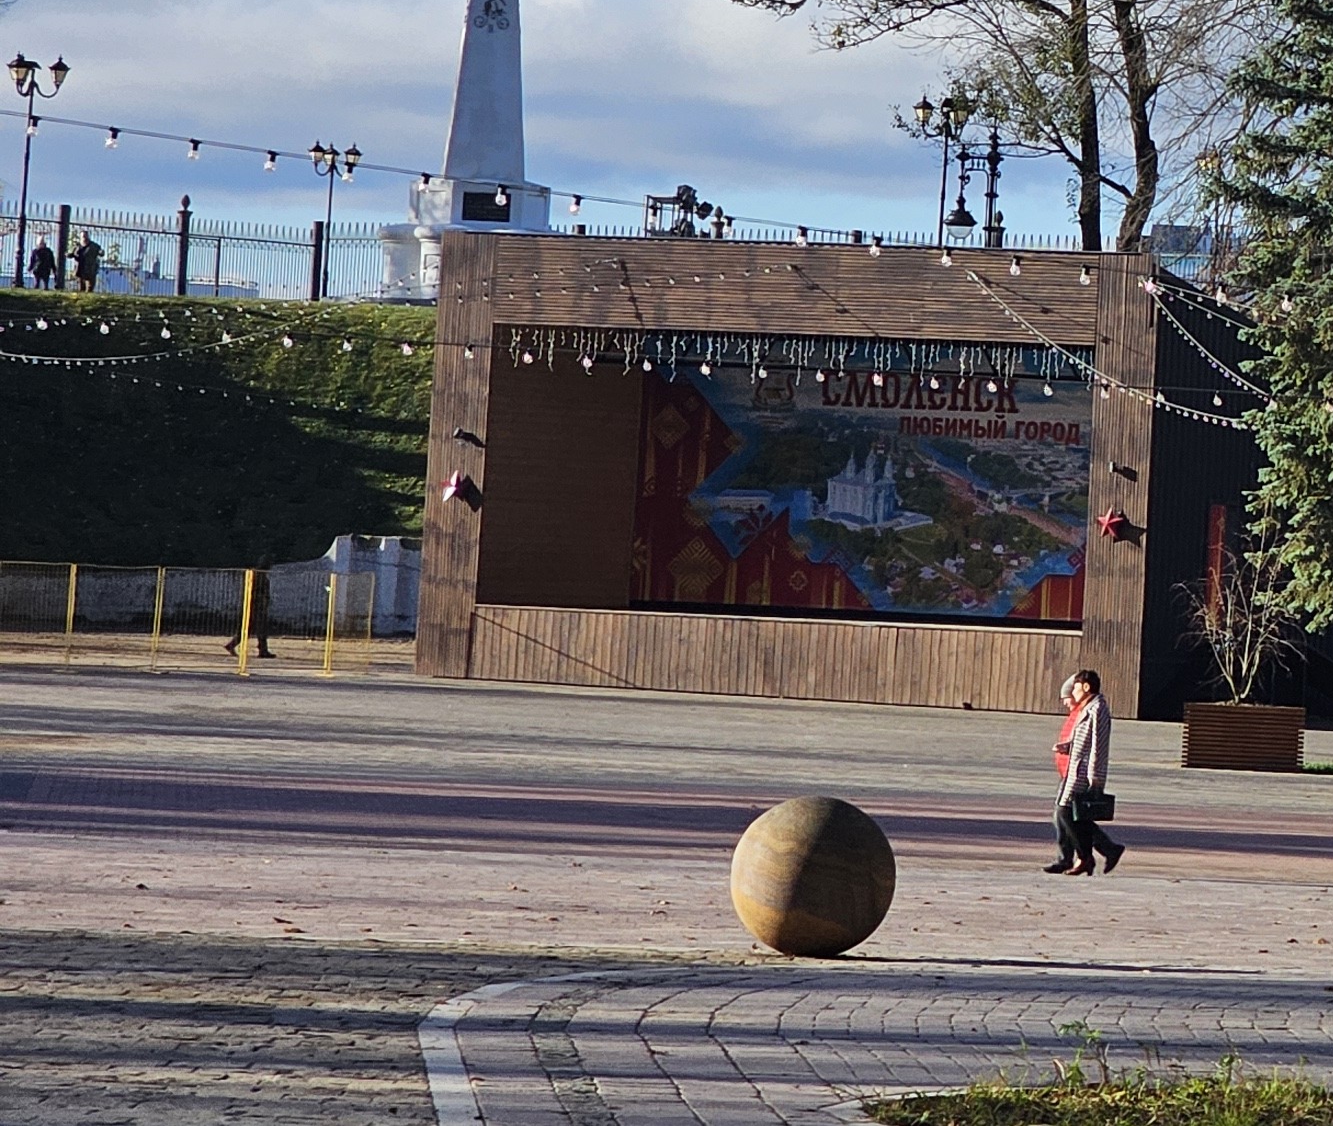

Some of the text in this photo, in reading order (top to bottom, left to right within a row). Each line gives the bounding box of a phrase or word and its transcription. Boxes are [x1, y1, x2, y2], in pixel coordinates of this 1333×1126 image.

[821, 370, 1019, 414] СМОЛЕНСК
[900, 415, 1080, 444] ЛЮБИМЫЙ ГОРОД
